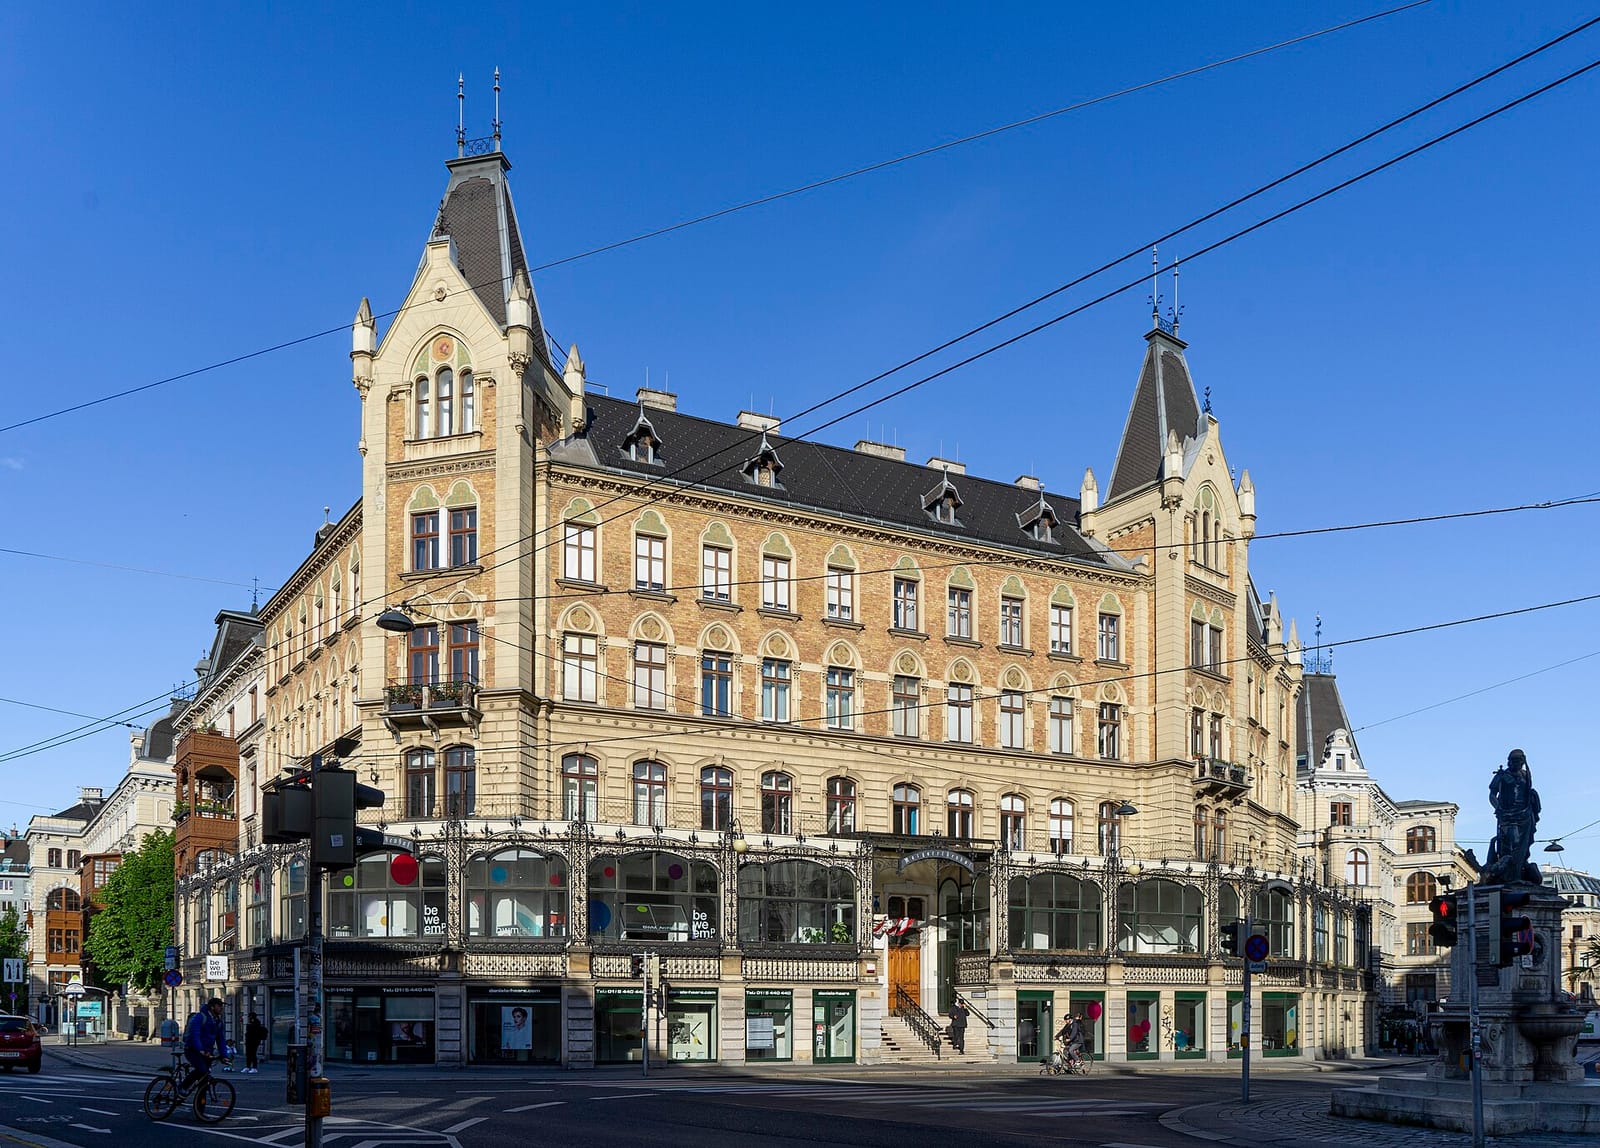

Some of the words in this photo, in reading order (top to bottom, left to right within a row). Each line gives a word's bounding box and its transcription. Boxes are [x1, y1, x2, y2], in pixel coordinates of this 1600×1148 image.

[424, 905, 438, 915] be
[692, 910, 708, 920] be
[424, 916, 440, 924] we
[692, 921, 709, 930] we
